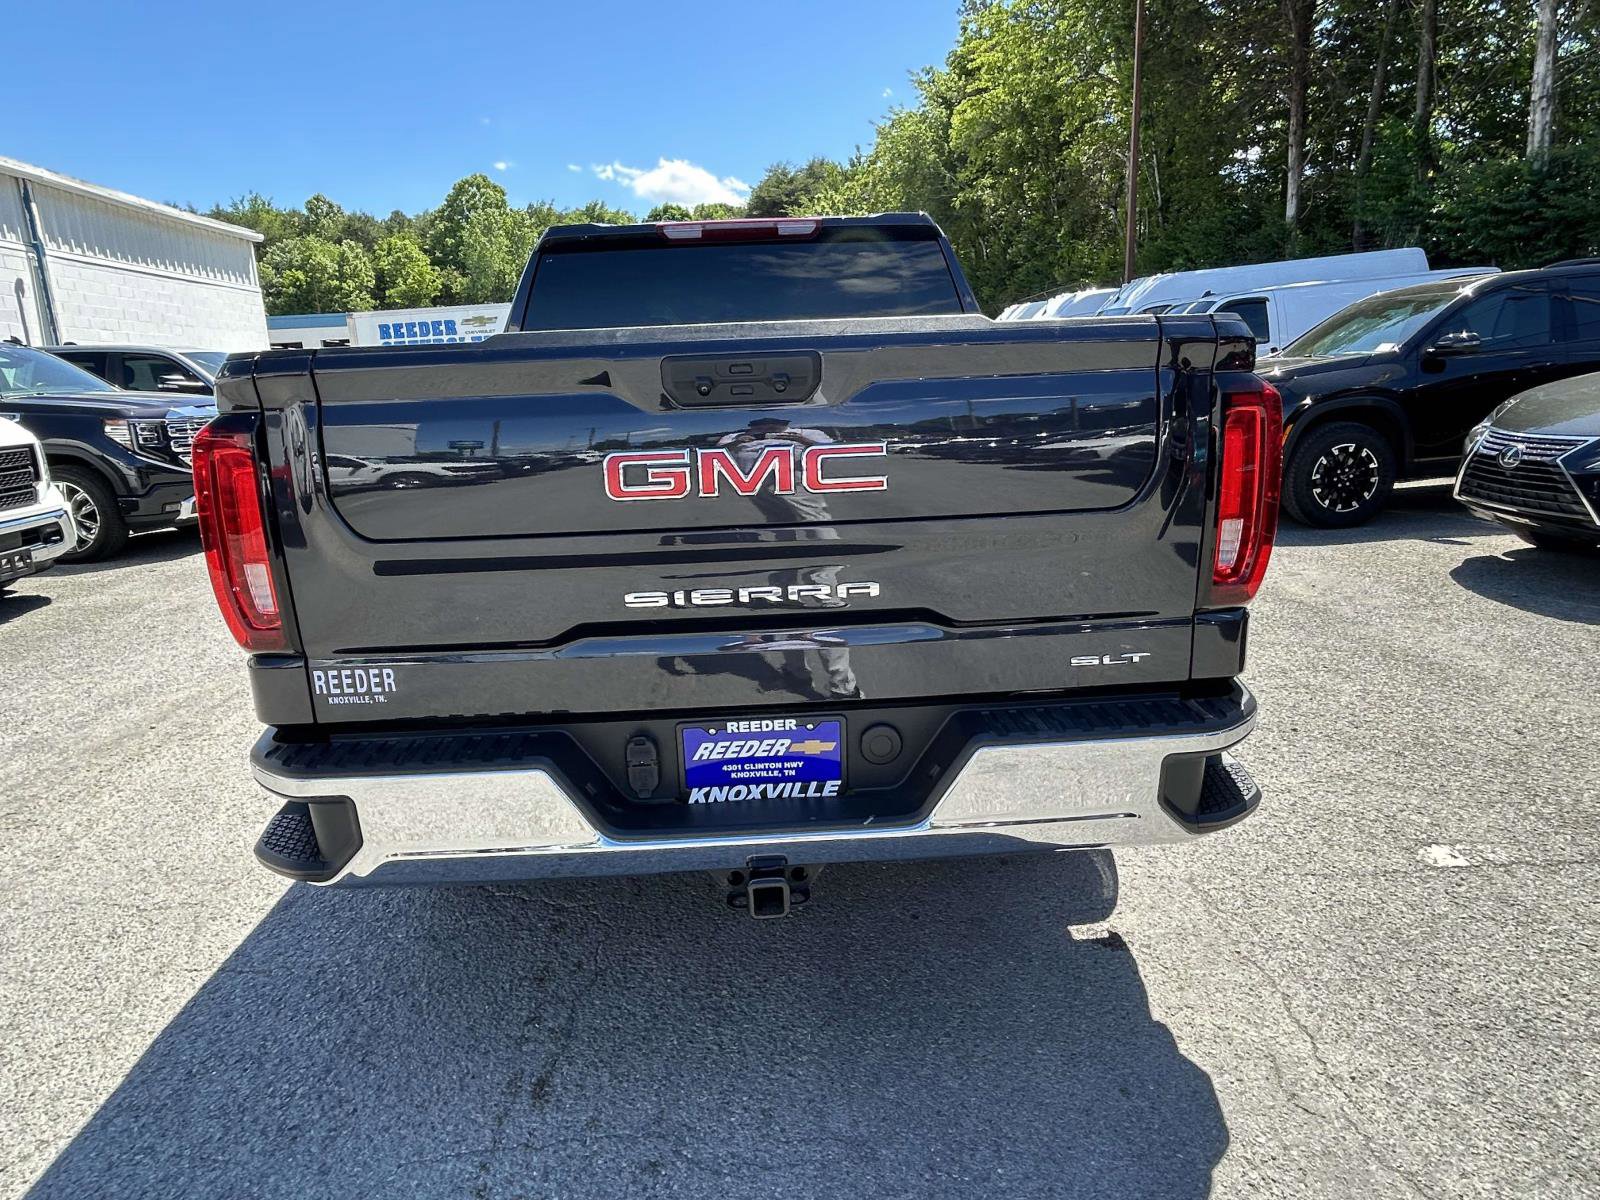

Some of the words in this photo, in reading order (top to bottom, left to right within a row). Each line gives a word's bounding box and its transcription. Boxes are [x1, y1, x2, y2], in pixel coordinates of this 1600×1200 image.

[378, 319, 457, 340] REEDER
[603, 441, 888, 501] GMC
[624, 581, 880, 608] SIERRA
[1071, 652, 1151, 667] SLT
[313, 668, 396, 694] REEDER
[328, 695, 373, 704] KNOXVILLE,
[726, 719, 797, 733] REEDER
[692, 738, 791, 760] REEDER
[731, 770, 782, 779] KNOXVILLE,
[784, 769, 796, 777] TN
[744, 762, 782, 771] CLINTON
[784, 761, 804, 769] HWY
[688, 780, 842, 804] KNOXVILLE
